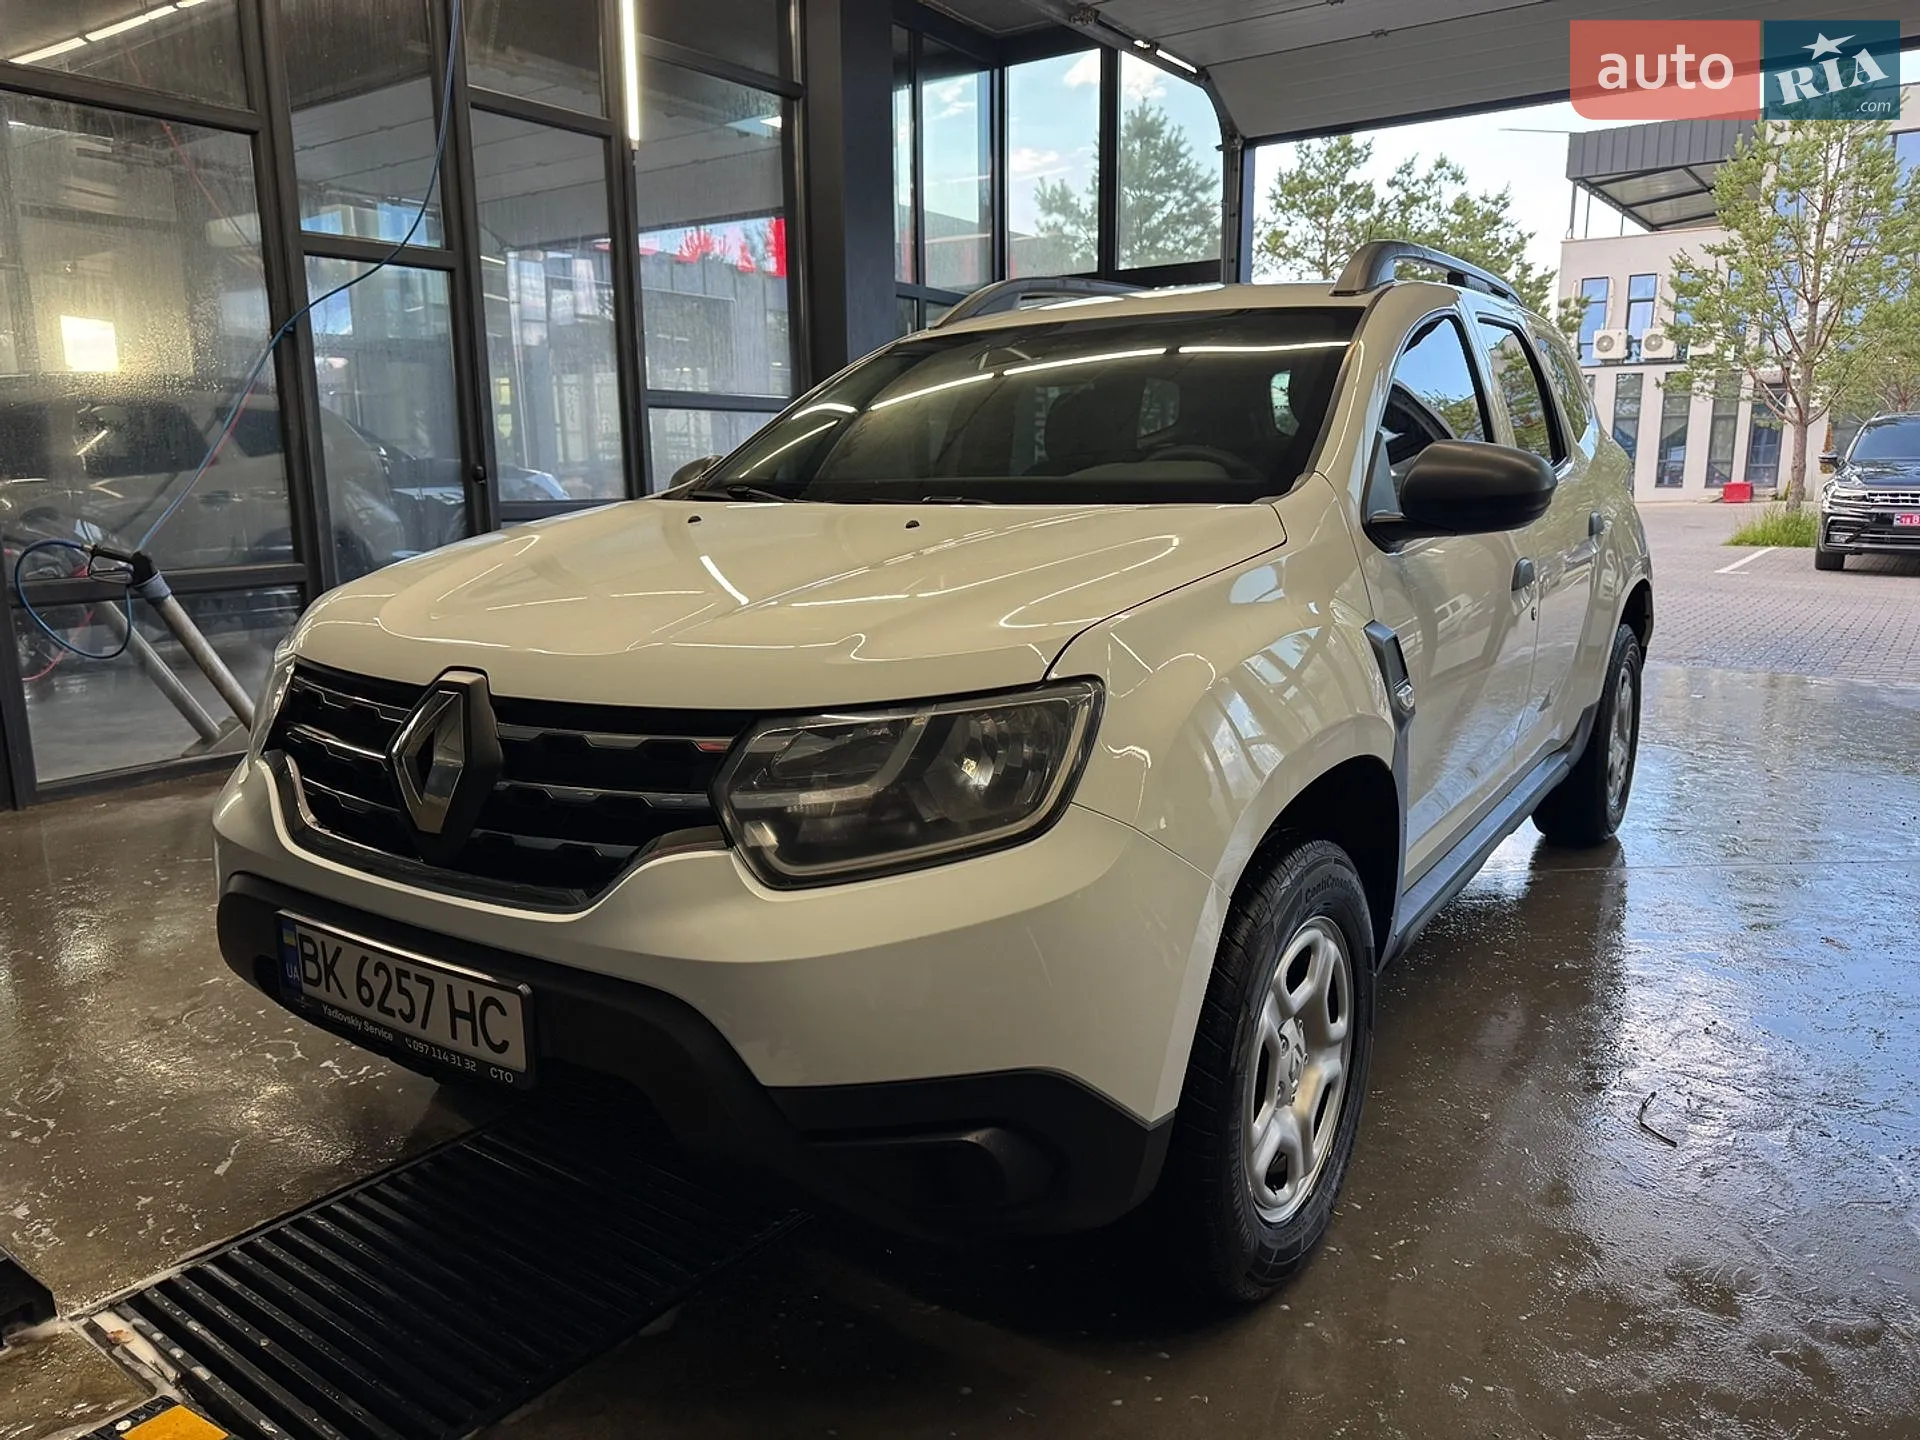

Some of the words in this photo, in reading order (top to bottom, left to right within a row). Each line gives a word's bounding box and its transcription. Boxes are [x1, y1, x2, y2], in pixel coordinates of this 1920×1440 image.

[286, 962, 300, 982] UA
[297, 933, 348, 1000] BK
[356, 955, 435, 1031] 6257
[446, 983, 510, 1054] HC
[363, 1020, 394, 1042] Service
